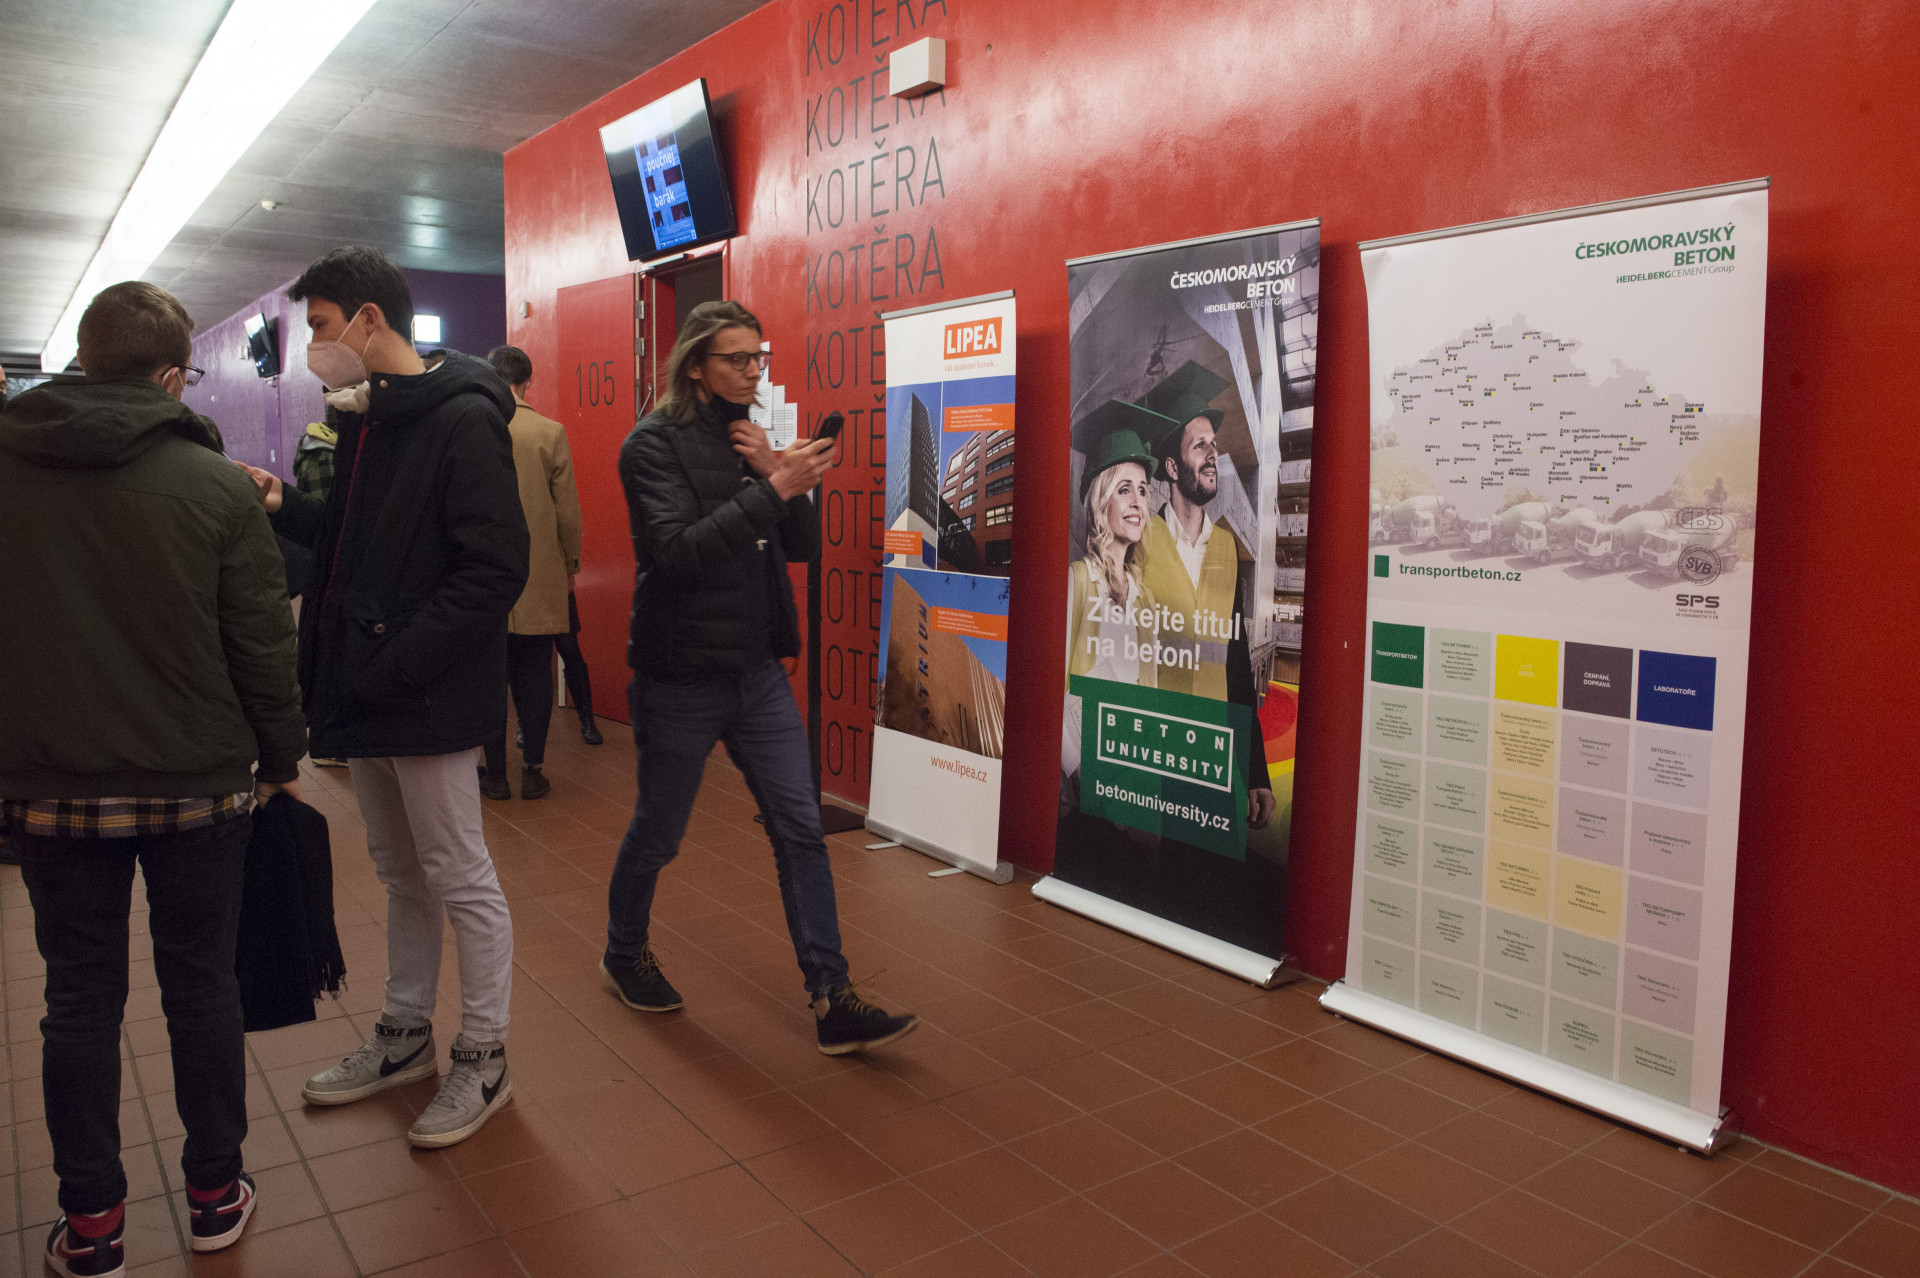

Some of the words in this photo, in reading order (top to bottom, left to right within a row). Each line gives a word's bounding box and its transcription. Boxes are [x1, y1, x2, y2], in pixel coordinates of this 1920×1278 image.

[647, 148, 675, 176] poučnej
[654, 188, 675, 208] barák
[806, 136, 945, 236] KOTĚRA
[1575, 222, 1736, 260] ČESKOMORAVSKÝ
[806, 224, 944, 314] KOTĚRA
[1674, 245, 1735, 266] BETON
[1170, 254, 1296, 290] ČESKOMORAVSKÝ
[1247, 278, 1296, 299] BETON
[947, 324, 997, 354] LIPEA
[576, 361, 614, 407] 105
[1399, 563, 1522, 582] transportbeton.cz
[1685, 556, 1712, 575] SVB
[1676, 594, 1720, 608] SPS
[1087, 599, 1185, 634] Získejte
[1193, 609, 1240, 640] titul
[1087, 636, 1115, 658] na
[1124, 634, 1200, 671] beton!
[1376, 650, 1417, 660] TRANSPORTBETON
[1584, 672, 1610, 681] ČERPÁNÍ,
[1584, 680, 1610, 688] DOPRAVA
[1654, 685, 1696, 696] LABORATOŘE
[1107, 714, 1225, 750] BETON
[931, 756, 987, 782] www.lipea.cz
[1106, 740, 1224, 779] UNIVERSITY
[1096, 780, 1230, 831] betonuniversity.cz
